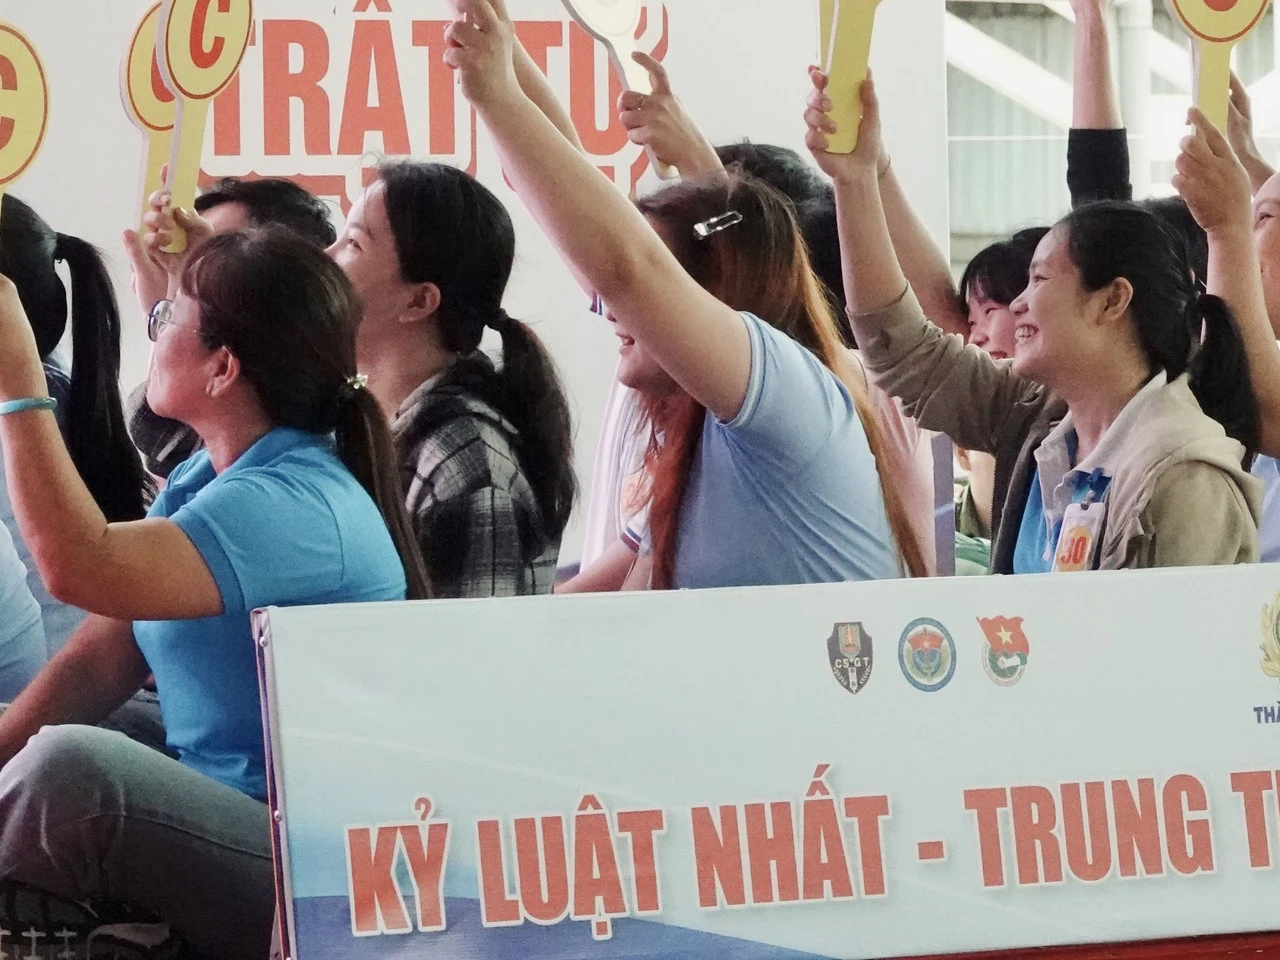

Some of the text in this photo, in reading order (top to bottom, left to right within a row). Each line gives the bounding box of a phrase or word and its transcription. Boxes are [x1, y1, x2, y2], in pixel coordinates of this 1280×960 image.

[348, 797, 449, 933] KỶ
[477, 794, 665, 936] LUẬT
[691, 764, 889, 908] NHẤT
[919, 841, 944, 859] -
[964, 773, 1214, 887] TRUNG
